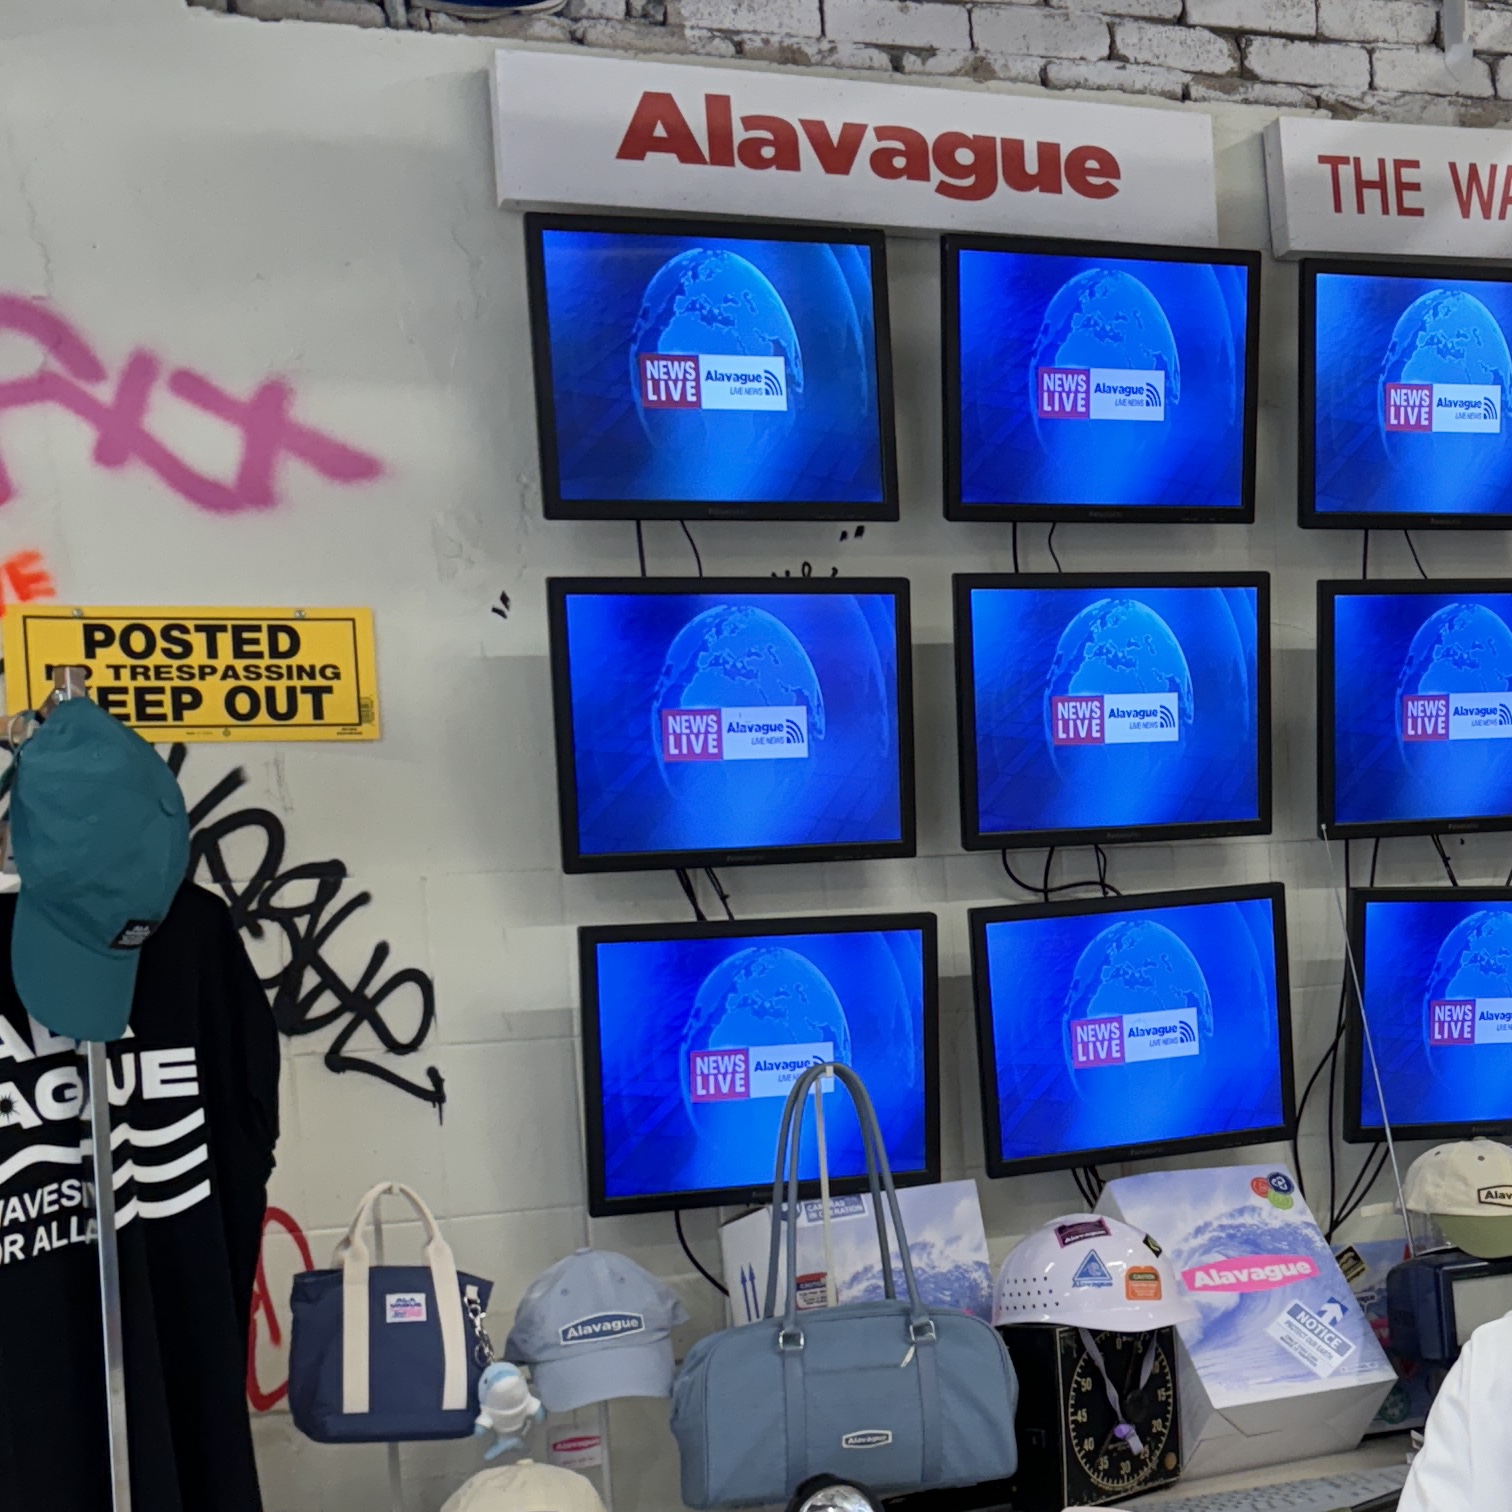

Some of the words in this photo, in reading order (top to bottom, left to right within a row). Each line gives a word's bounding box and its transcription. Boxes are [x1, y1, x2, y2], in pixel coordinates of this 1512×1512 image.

[616, 90, 1121, 201] Alavague
[1318, 154, 1424, 218] THE
[646, 360, 696, 380] NEWS
[704, 370, 762, 385] Alavague
[647, 380, 697, 402] LIVE
[1043, 373, 1087, 392] NEWS
[1094, 382, 1145, 397] Alavague
[1043, 392, 1086, 412] LIVE
[1390, 388, 1430, 406] NEWS
[1436, 398, 1482, 410] Alavague
[1390, 406, 1429, 426] LIVE
[83, 623, 301, 660] POSTED
[106, 664, 341, 681] TRESPASSING
[87, 685, 204, 722] EEP
[224, 685, 334, 721] OUT
[1058, 701, 1100, 719] NEWS
[1408, 700, 1446, 717] NEWS
[1453, 706, 1497, 717] Alavague
[1108, 708, 1158, 719] Alavague
[668, 714, 718, 734] NEWS
[727, 721, 784, 734] Alavague
[1058, 719, 1100, 739] LIVE
[1408, 717, 1446, 735] LIVE
[669, 734, 718, 755] LIVE
[1435, 1004, 1472, 1022] NEWS
[1077, 1022, 1120, 1042] NEWS
[1128, 1024, 1177, 1038] Alavague
[1434, 1021, 1472, 1039] LIVE
[1078, 1040, 1120, 1062] LIVE
[696, 1054, 745, 1075] NEWS
[754, 1060, 811, 1072] Alavague
[696, 1073, 746, 1096] LIVE
[0, 1178, 82, 1227] AVES
[33, 1214, 91, 1257] ALL
[1194, 1261, 1312, 1288] Alavague
[566, 1318, 639, 1339] Alavague
[1294, 1309, 1343, 1350] NOTICE
[1081, 1378, 1092, 1392] 50
[1076, 1408, 1087, 1422] 45
[1152, 1419, 1162, 1433] 20
[1084, 1438, 1095, 1450] 40
[1120, 1461, 1131, 1475] 30
